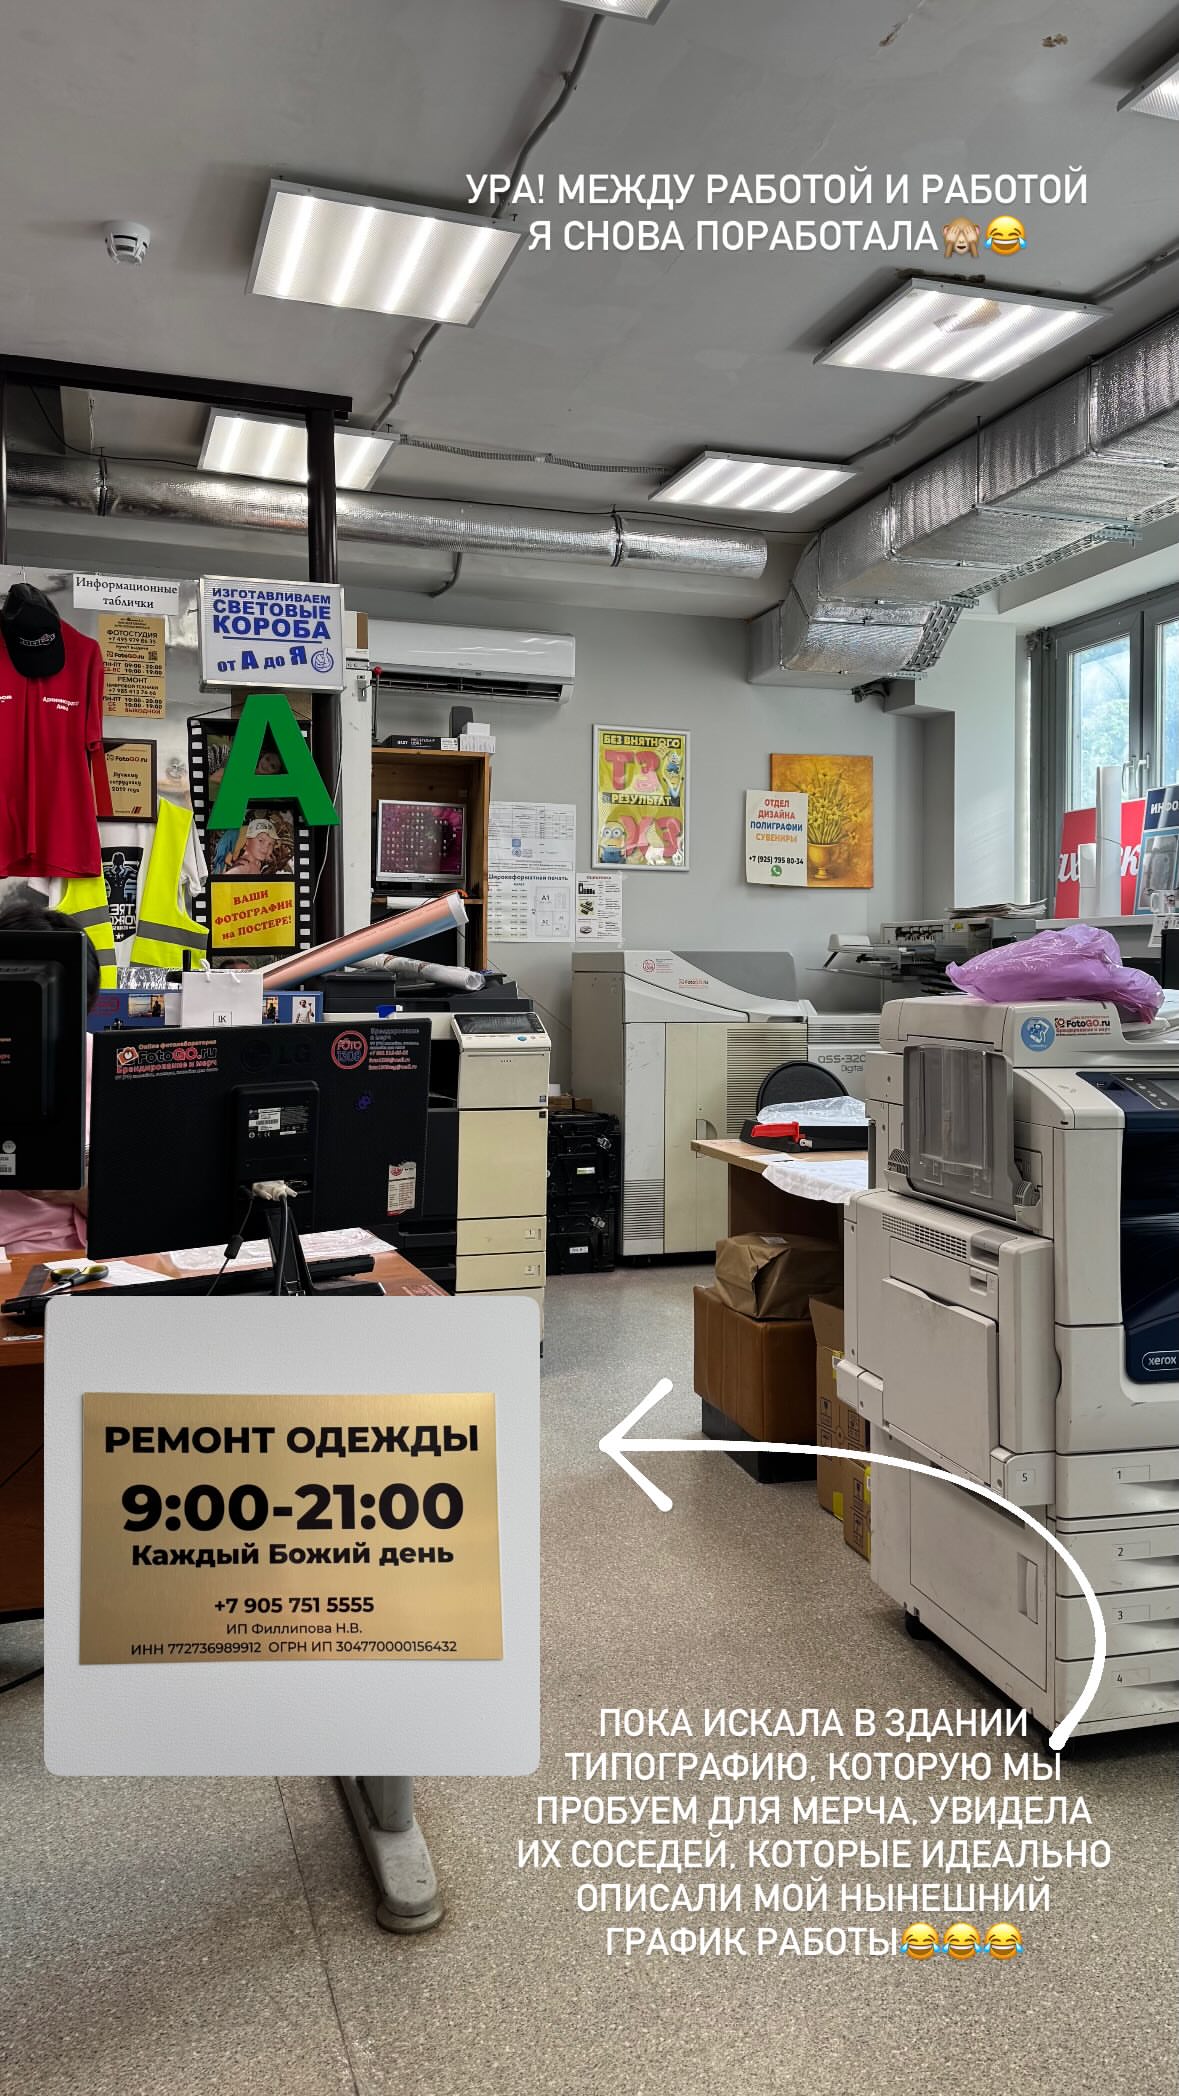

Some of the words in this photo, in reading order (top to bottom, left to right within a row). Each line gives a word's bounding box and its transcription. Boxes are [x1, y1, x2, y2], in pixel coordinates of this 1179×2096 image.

[76, 576, 178, 594] Информационные
[103, 596, 154, 609] таблички
[212, 587, 331, 604] ИЗГОТАВЛИВАЕМ
[213, 599, 331, 620] СВЕТОВЫЕ
[106, 629, 158, 638] ФОТОСТУДИЯ
[213, 615, 331, 639] КОРОБА
[217, 660, 236, 672] от
[241, 650, 259, 670] А
[263, 656, 285, 670] до
[289, 646, 308, 666] Я
[603, 734, 622, 745] БЕЗ
[623, 735, 681, 749] ВНЯТНОГО
[605, 749, 661, 793] ТЗ
[611, 793, 671, 807] РЕЗУЛЬТАТ
[764, 799, 790, 808] ОТДЕЛ
[758, 809, 795, 820] ДИЗАЙНА
[750, 821, 803, 832] ПОЛИГРАФИИ
[756, 833, 797, 843] СУВЕНИРЫ
[757, 856, 773, 865] (925)
[787, 857, 804, 865] 80-34
[233, 889, 269, 906] ВАШИ
[215, 900, 293, 926] ФОТОГРАФИИ
[222, 932, 235, 941] на
[238, 915, 292, 938] ПОСТЕРЕ!
[1067, 1020, 1110, 1028] FotoGO.ru
[138, 1047, 217, 1065] FotoGO.ru
[116, 1063, 188, 1074] Брендирование
[841, 1064, 864, 1073] Digital
[1148, 1356, 1177, 1366] xerox
[105, 1426, 275, 1454] РЕМОНТ
[286, 1425, 479, 1458] ОДЕЖДЫ
[1117, 1471, 1121, 1480] 1
[121, 1483, 464, 1533] 9:00-21:00
[132, 1542, 260, 1569] Каждый
[269, 1541, 371, 1566] Божий
[379, 1545, 455, 1568] день
[1118, 1548, 1124, 1557] 2
[214, 1598, 238, 1614] +7
[244, 1598, 283, 1613] 905
[288, 1597, 321, 1613] 751
[326, 1597, 375, 1613] 5555
[1118, 1611, 1124, 1620] 3
[226, 1624, 248, 1635] ИП
[251, 1623, 332, 1637] Филлипова
[336, 1623, 363, 1634] Н.В.
[131, 1644, 164, 1656] ИНН
[168, 1642, 262, 1655] 772736989912
[268, 1641, 307, 1653] ОГРН
[311, 1641, 333, 1652] ИП
[336, 1641, 457, 1653] 304770000156432
[1116, 1674, 1123, 1683] 4
